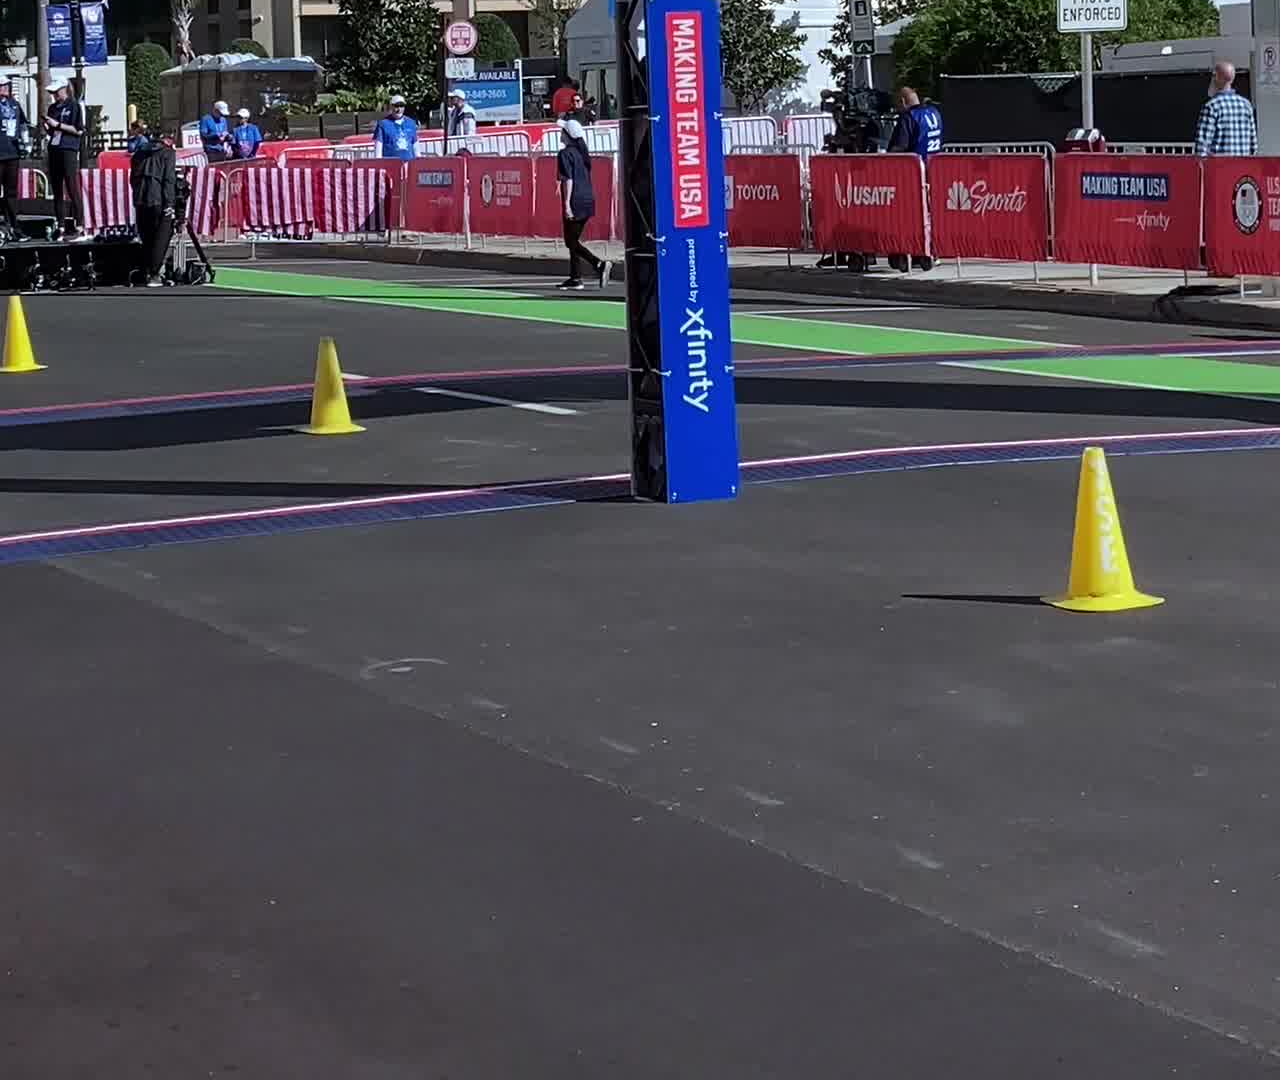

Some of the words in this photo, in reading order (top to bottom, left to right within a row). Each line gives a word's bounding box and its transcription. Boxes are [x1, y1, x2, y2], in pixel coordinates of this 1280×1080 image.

[1062, 7, 1121, 23] ENFORCED
[672, 18, 698, 103] MAKING
[478, 71, 517, 80] AVAILABLE
[676, 108, 699, 166] TEAM
[679, 174, 703, 220] USA
[736, 184, 780, 201] TOYOTA
[853, 186, 896, 206] USATF
[970, 179, 1027, 217] Sports
[1082, 176, 1118, 195] MAKING
[1119, 177, 1144, 196] TEAM
[1146, 178, 1167, 197] USA
[1136, 209, 1170, 232] xfinity
[686, 238, 699, 289] presented
[688, 290, 699, 303] by
[679, 307, 714, 413] xfinity
